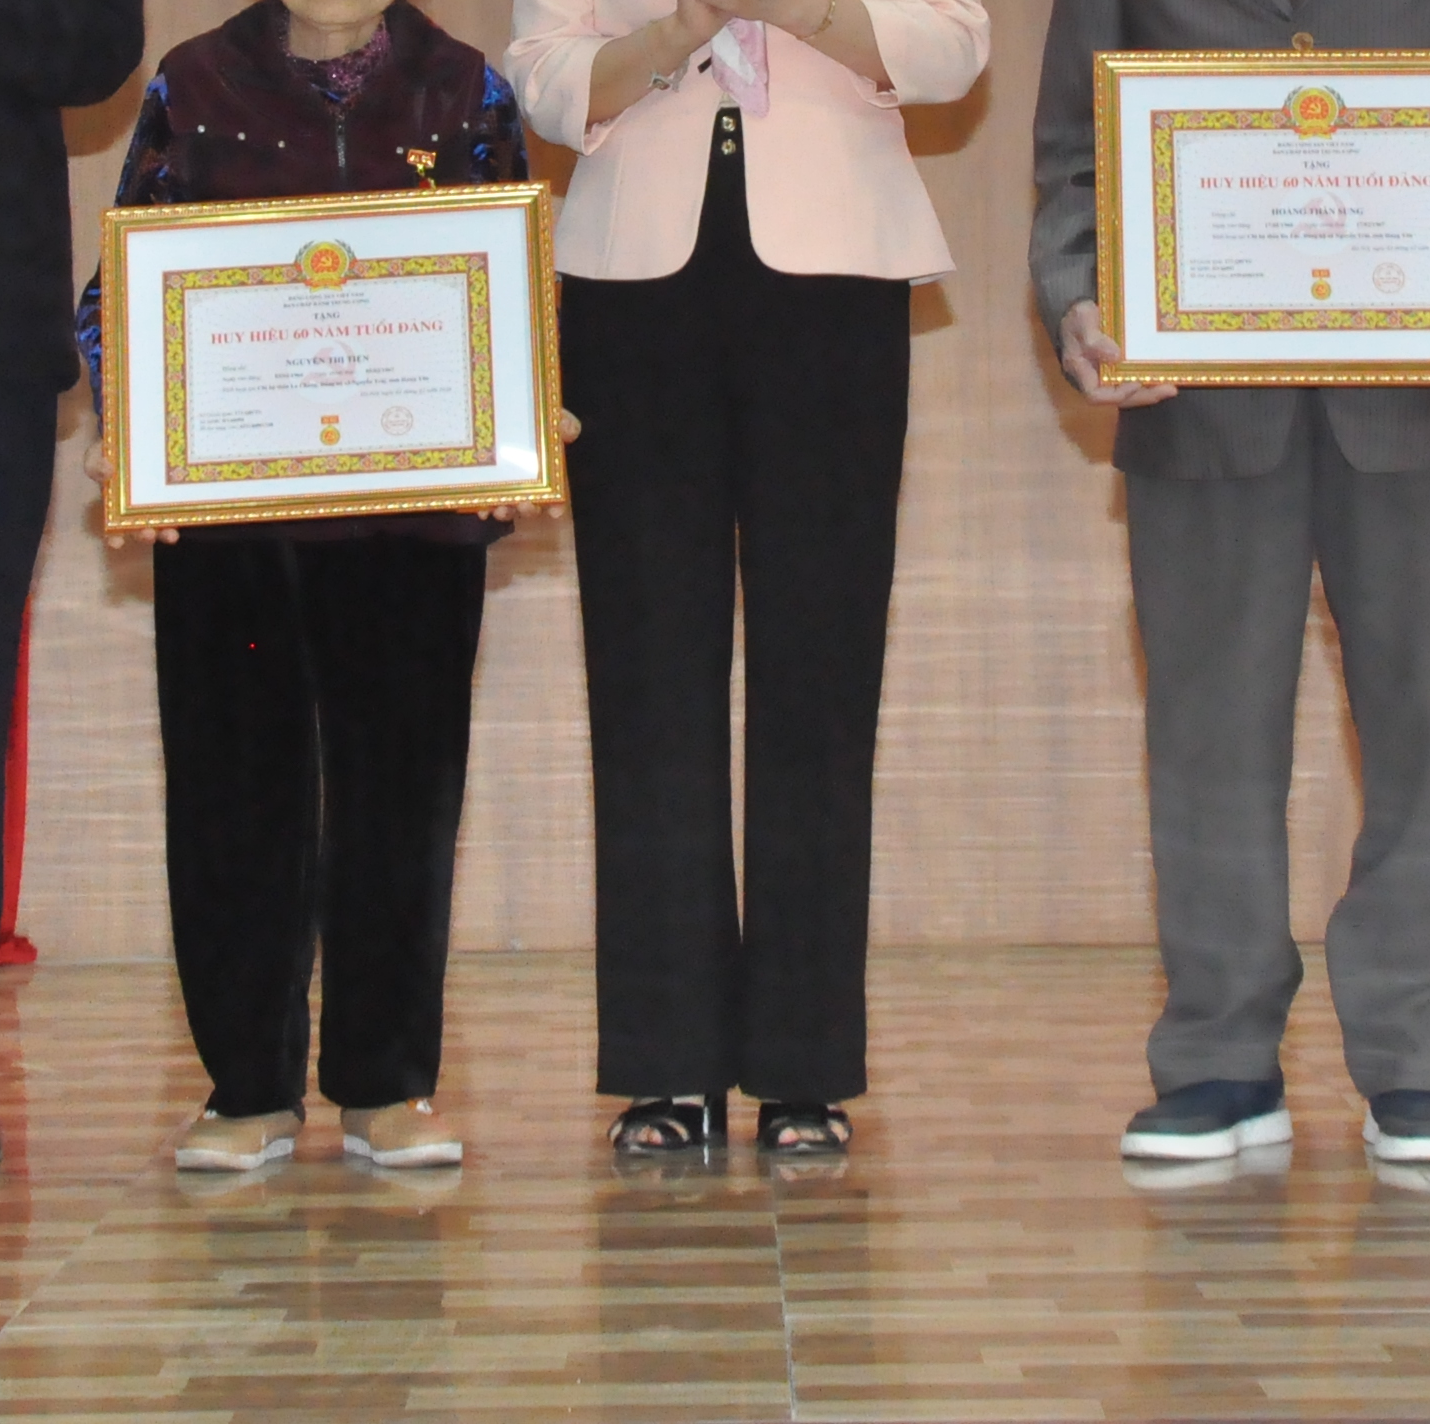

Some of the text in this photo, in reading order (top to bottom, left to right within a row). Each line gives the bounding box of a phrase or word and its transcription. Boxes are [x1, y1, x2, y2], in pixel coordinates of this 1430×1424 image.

[1200, 176, 1234, 189] HUY
[1283, 176, 1299, 188] 60
[210, 331, 245, 345] HUY
[293, 328, 309, 340] 60
[398, 318, 444, 334] ĐẢNG
